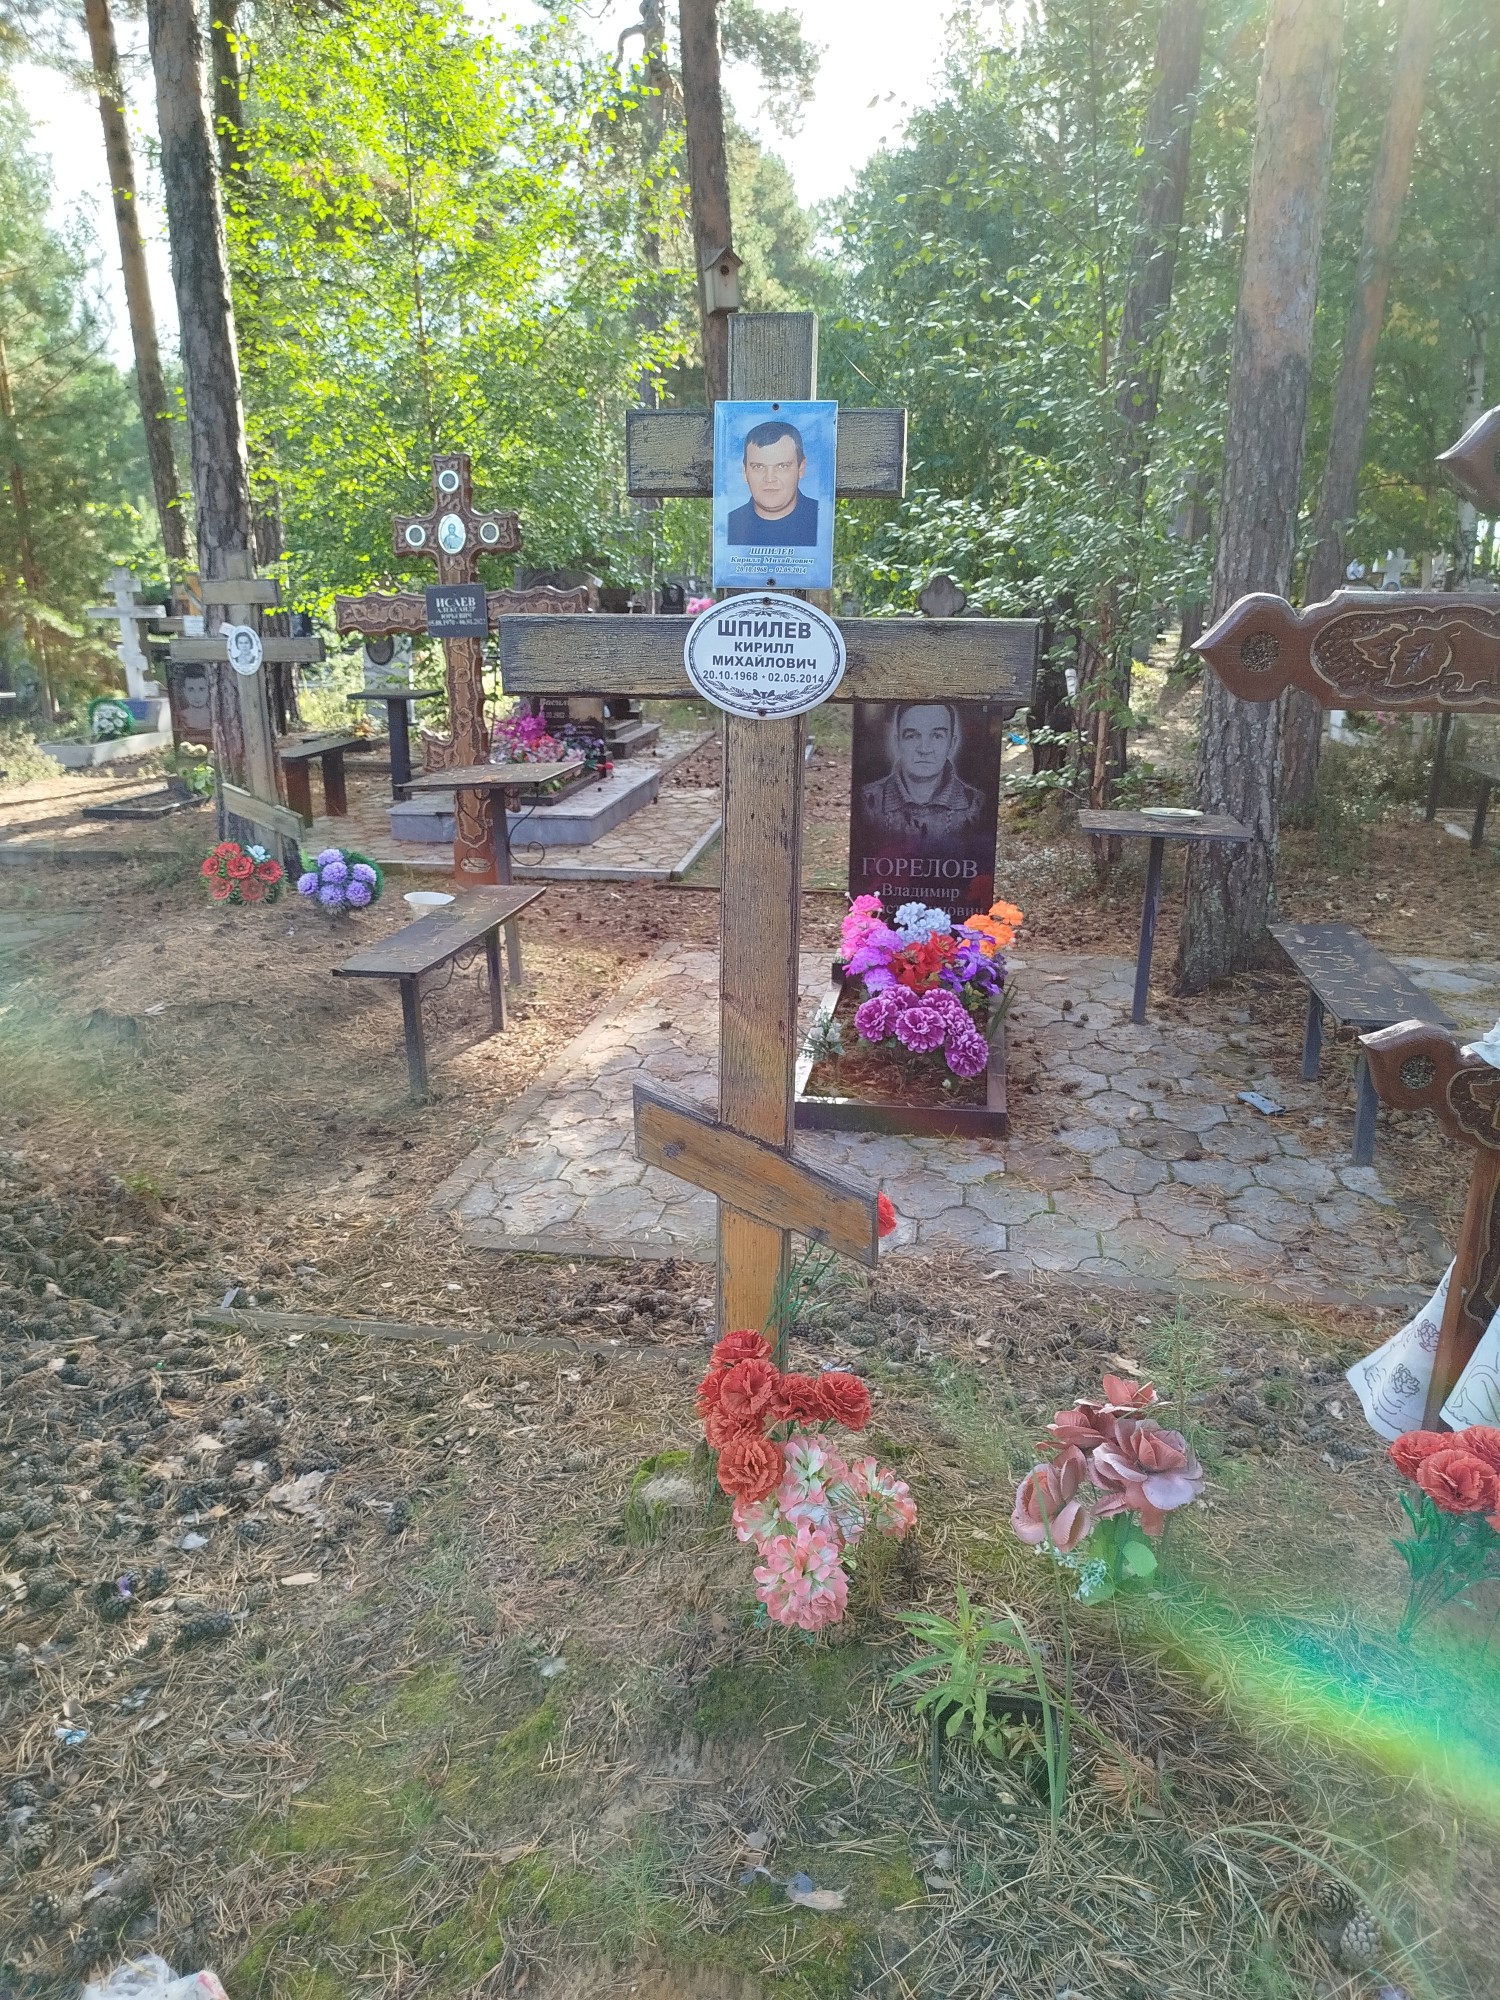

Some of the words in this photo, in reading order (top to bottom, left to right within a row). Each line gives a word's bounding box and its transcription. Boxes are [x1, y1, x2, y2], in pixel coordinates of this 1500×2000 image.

[750, 547, 795, 555] ШПИЛЕВ
[730, 556, 761, 565] Кирилл
[763, 556, 814, 565] Михайлович
[436, 597, 476, 607] ИСАЕВ
[717, 620, 812, 639] ШПИЛЕВ
[734, 641, 794, 654] КИРИЛЛ
[712, 654, 817, 670] МИХАЙЛОВИЧ
[702, 669, 758, 681] 20.10.1968
[767, 674, 825, 684] 02.05.2014
[861, 857, 978, 879] ГОРЕЛОВ
[882, 883, 960, 901] Владимир
